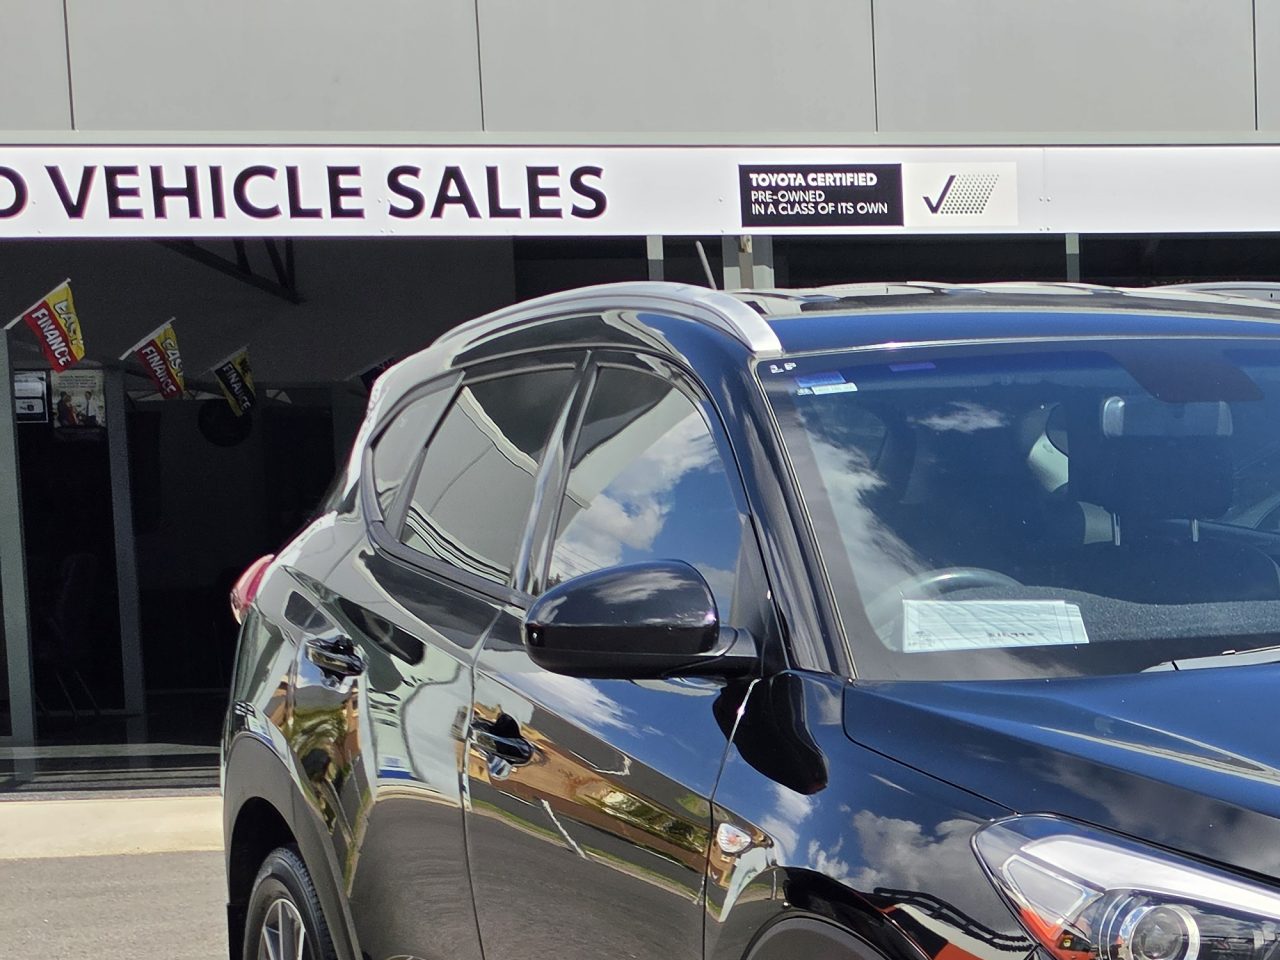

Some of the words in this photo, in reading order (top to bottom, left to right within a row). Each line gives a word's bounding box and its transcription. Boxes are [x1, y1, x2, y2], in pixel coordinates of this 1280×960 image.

[749, 173, 806, 187] TOYOTA
[807, 172, 878, 186] CERTIFIED
[45, 165, 365, 219] VEHICLE
[386, 164, 608, 219] SALES
[751, 190, 826, 202] PRE-OWNED
[752, 203, 765, 215] IN
[767, 203, 777, 215] A
[778, 203, 816, 215] CLASS
[817, 203, 836, 214] OF
[838, 203, 855, 214] ITS
[856, 202, 889, 214] OWN
[31, 308, 71, 366] FINANCE
